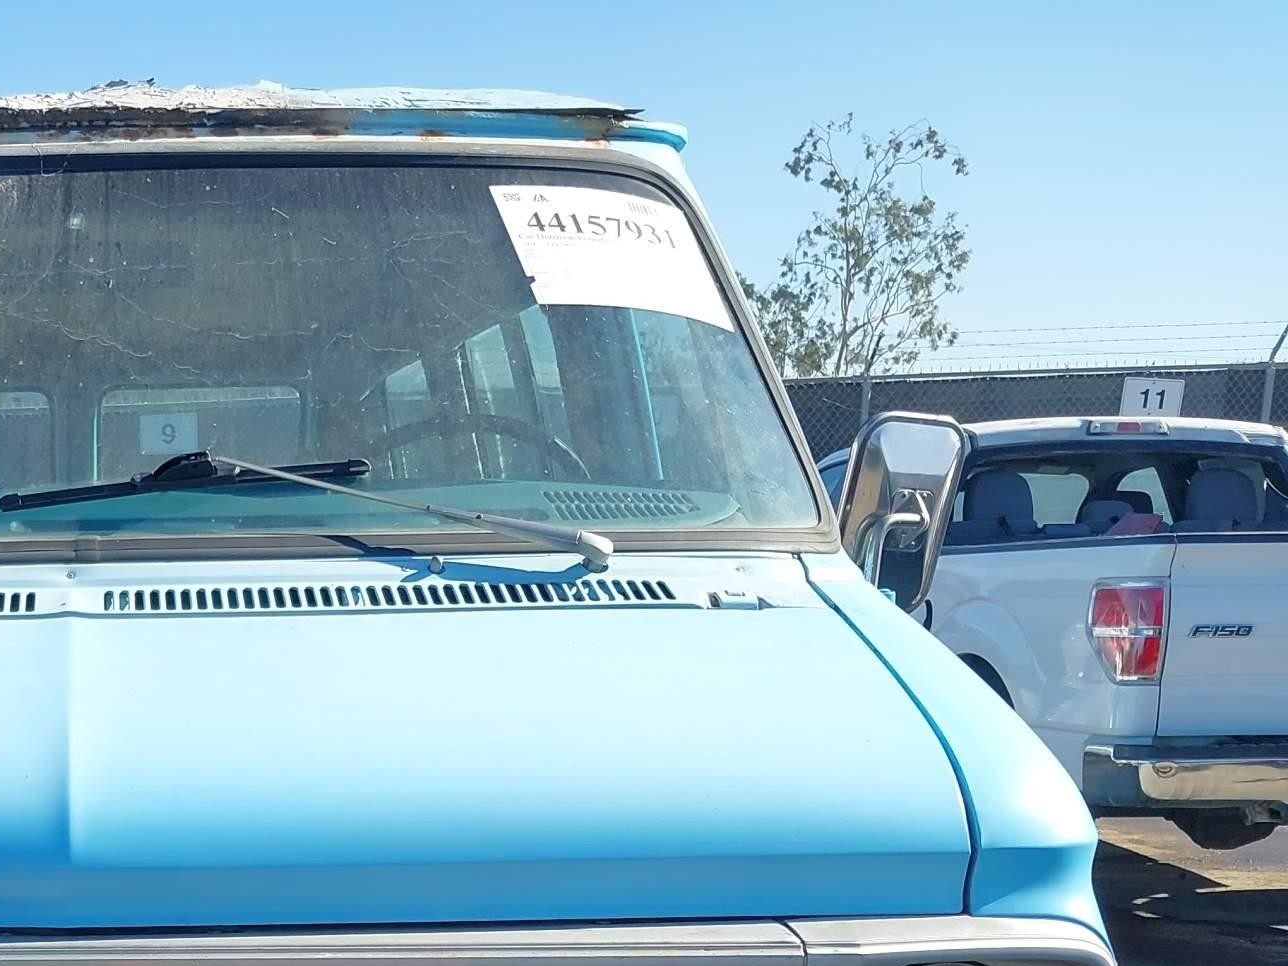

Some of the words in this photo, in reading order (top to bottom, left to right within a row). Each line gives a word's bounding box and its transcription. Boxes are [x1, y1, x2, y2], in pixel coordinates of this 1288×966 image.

[527, 211, 676, 249] 44157931
[1140, 388, 1165, 410] 11
[161, 423, 176, 444] 9
